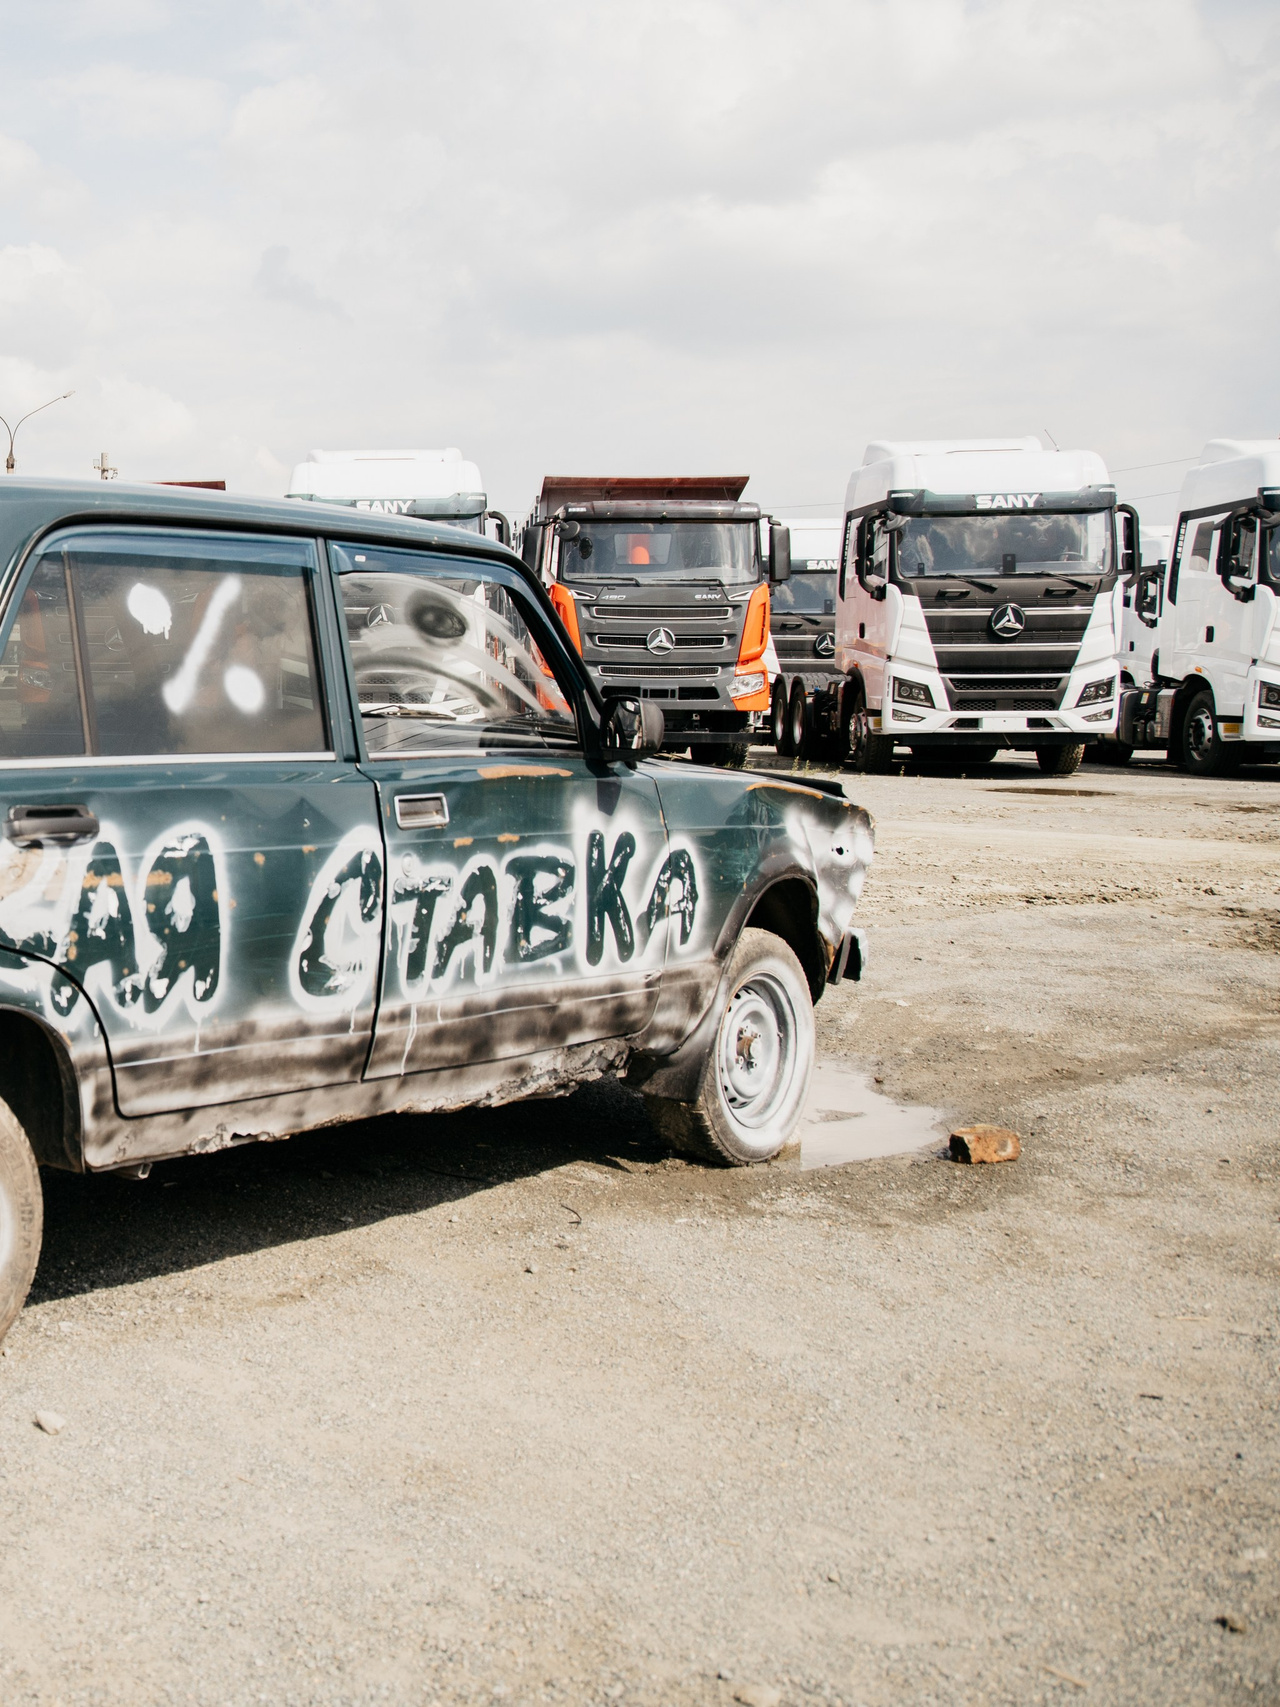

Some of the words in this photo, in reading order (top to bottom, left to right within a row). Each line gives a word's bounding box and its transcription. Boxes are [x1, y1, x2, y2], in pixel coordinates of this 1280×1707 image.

[356, 500, 412, 514] SANY
[975, 492, 1039, 509] SANY
[806, 560, 839, 570] SAN
[291, 808, 706, 1012] СТАВКА
